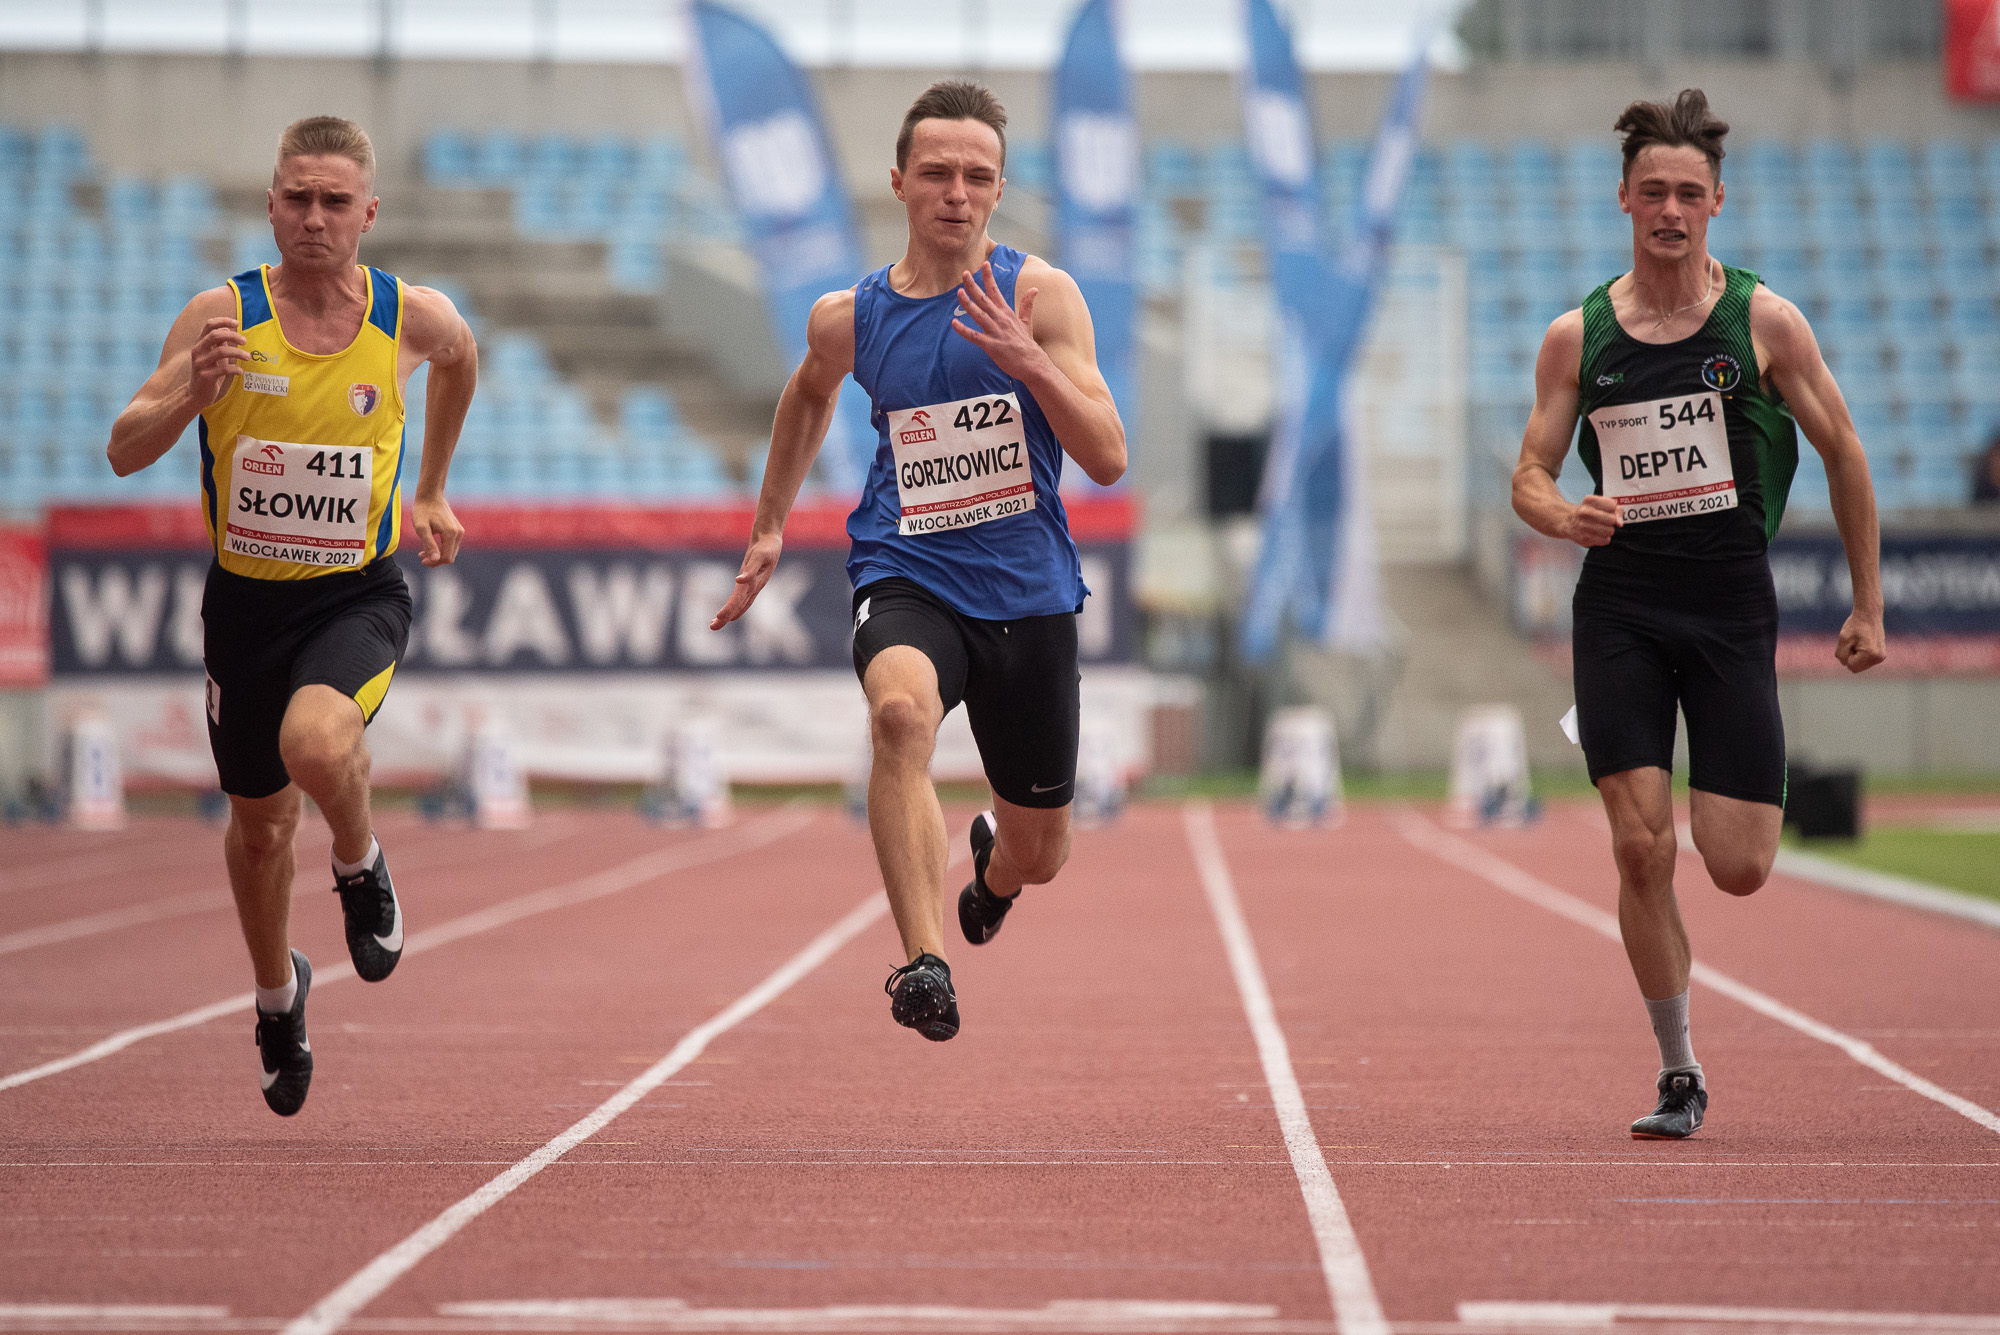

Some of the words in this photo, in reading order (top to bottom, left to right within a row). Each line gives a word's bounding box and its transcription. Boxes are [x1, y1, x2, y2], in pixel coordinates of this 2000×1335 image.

[254, 382, 288, 393] WIELICKI
[255, 376, 284, 386] POWIAT
[954, 399, 1013, 432] 422
[1599, 420, 1617, 430] TVP
[1618, 416, 1648, 428] SPORT
[1660, 398, 1715, 430] 544
[902, 429, 935, 444] ORLEN
[244, 460, 282, 475] ORLEN
[306, 451, 365, 479] 411
[901, 441, 1023, 489] GORZKOWICZ
[1620, 445, 1708, 480] DEPTA
[238, 487, 358, 523] SŁOWIK
[916, 505, 934, 513] PZLA
[934, 496, 985, 511] MISTRZOSTWA
[986, 489, 1012, 500] POLSKI
[1013, 485, 1027, 494] U18
[1636, 490, 1688, 503] MISTRZOSTWA
[1689, 486, 1715, 496] POLSKI
[1699, 494, 1730, 511] 2021
[907, 505, 993, 532] WŁOCŁAWEK
[995, 498, 1027, 516] 2021
[231, 538, 321, 563] WŁOCŁAWEK
[325, 552, 356, 565] 2021
[242, 529, 262, 539] PZLA
[262, 534, 318, 545] MISTRZOSTWA
[318, 539, 345, 548] POLSKI
